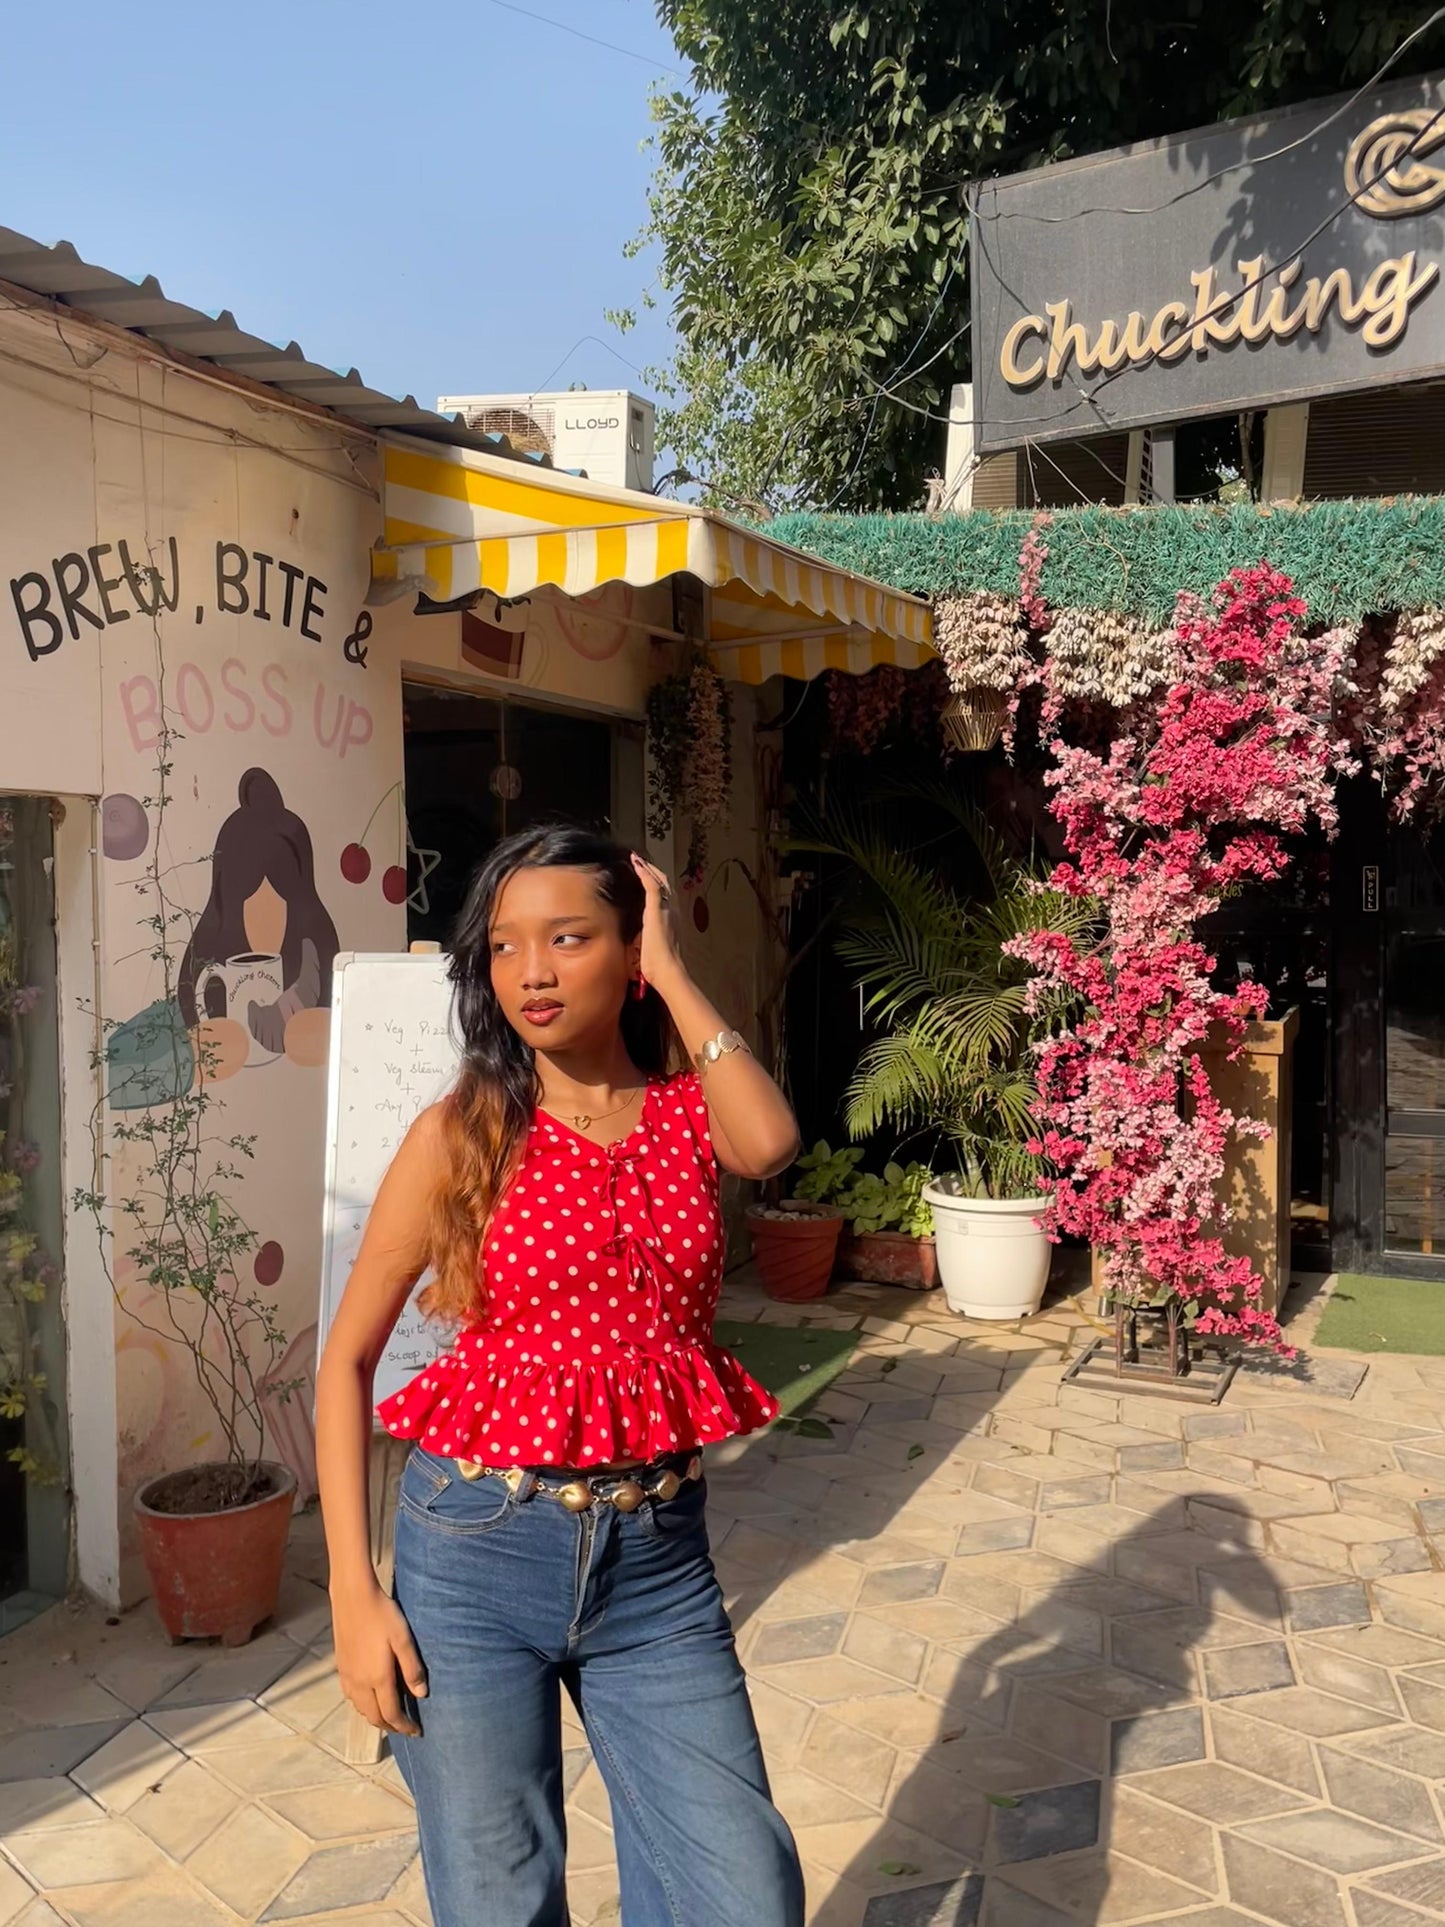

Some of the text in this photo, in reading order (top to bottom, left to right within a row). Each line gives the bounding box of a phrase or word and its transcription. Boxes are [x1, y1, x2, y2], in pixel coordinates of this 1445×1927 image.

[1000, 251, 1440, 386] Chuckling
[566, 418, 619, 430] LLOYD
[216, 540, 329, 643] BITE
[343, 610, 373, 669] &
[119, 657, 374, 759] BOSS UP
[383, 1018, 451, 1045] Veg Pizz
[383, 1062, 402, 1087] Veg
